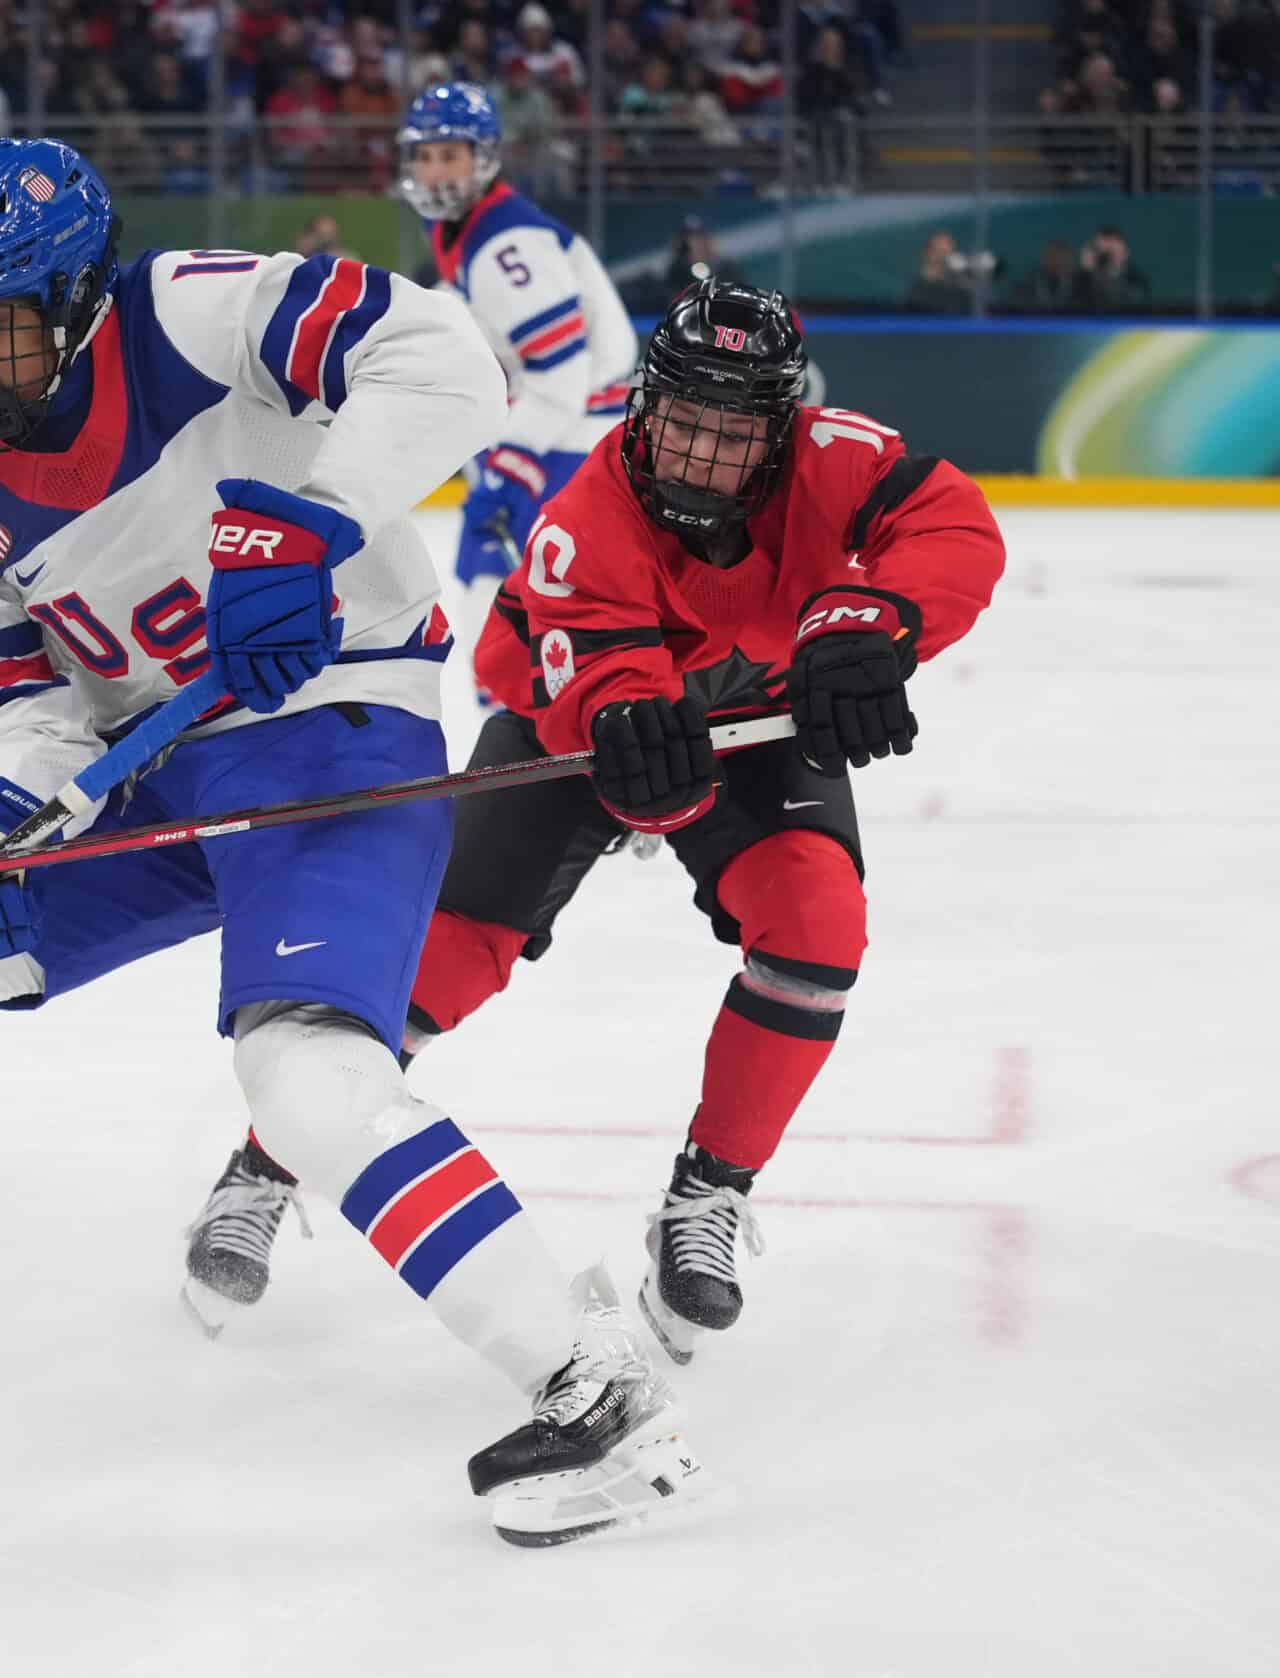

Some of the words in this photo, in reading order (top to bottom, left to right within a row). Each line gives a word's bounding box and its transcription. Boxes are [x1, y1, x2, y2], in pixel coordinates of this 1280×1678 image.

[495, 244, 532, 290] 5
[714, 325, 746, 352] 10
[583, 1387, 626, 1428] BAUER
